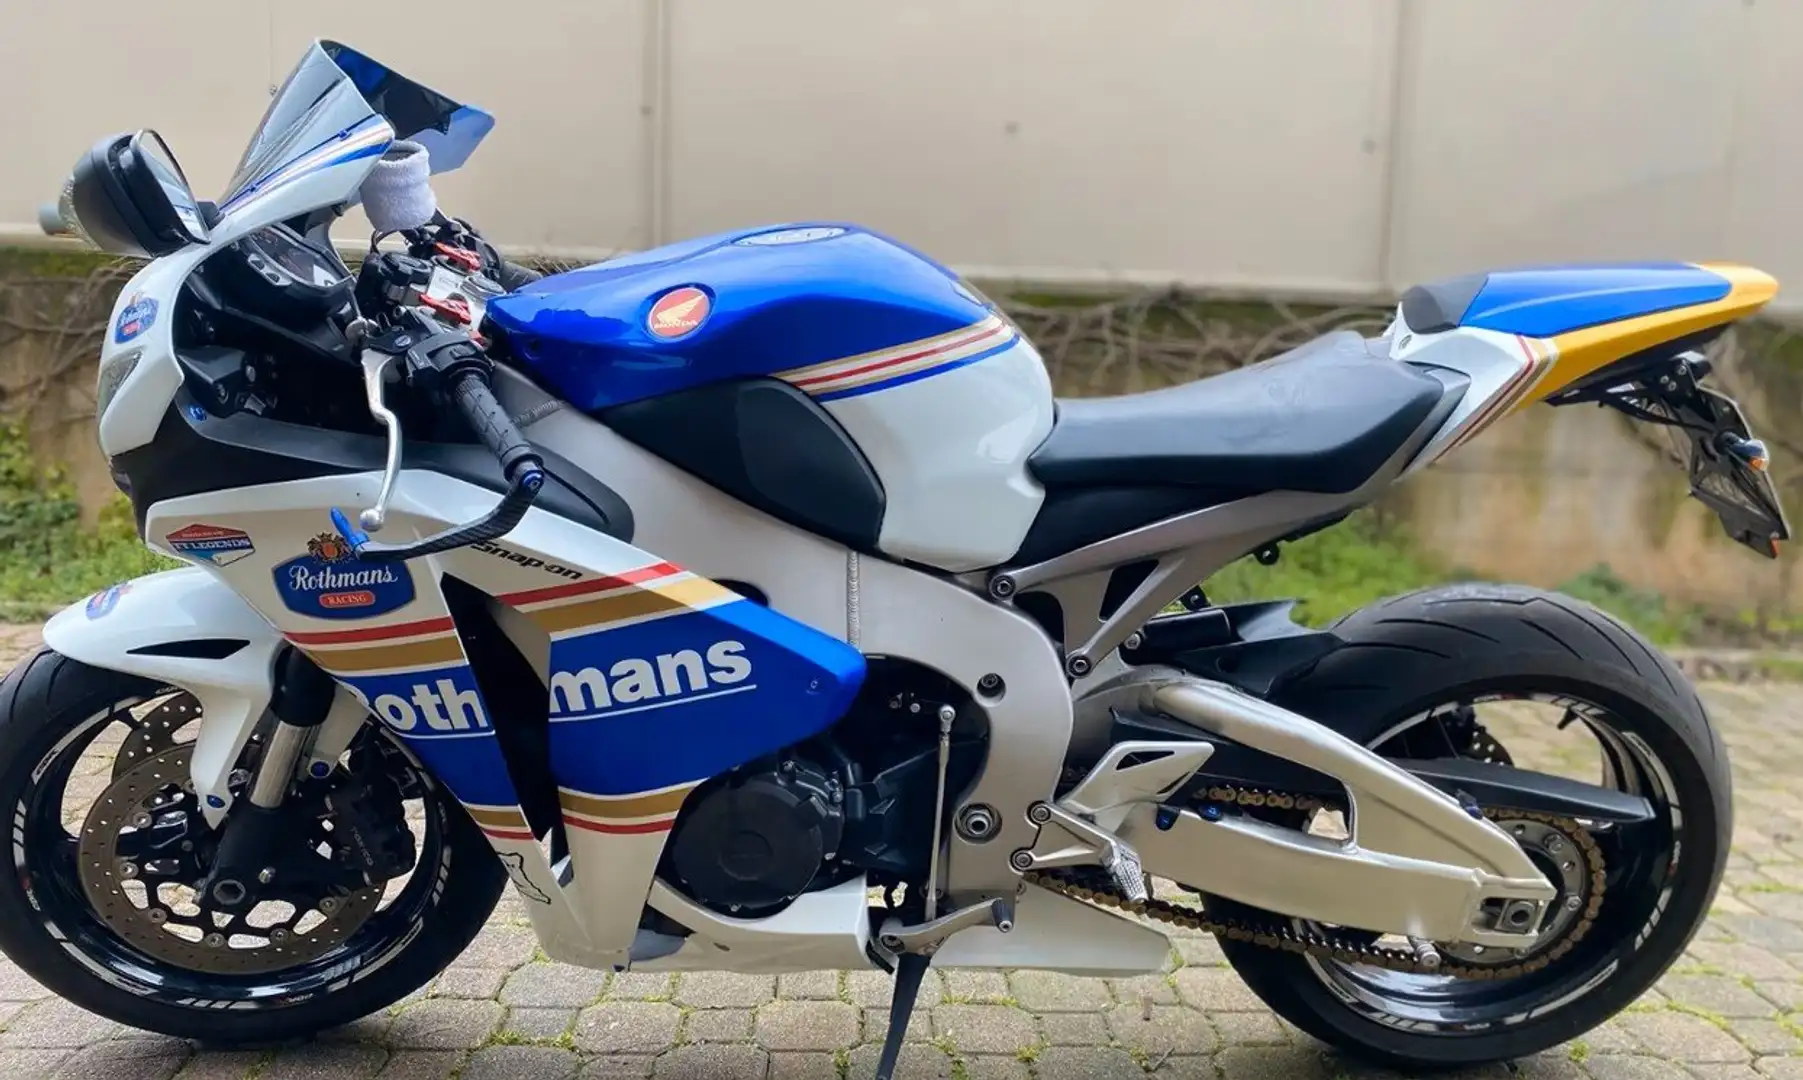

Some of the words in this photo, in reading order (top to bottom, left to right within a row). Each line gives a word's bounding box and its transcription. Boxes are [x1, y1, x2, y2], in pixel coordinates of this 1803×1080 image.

[190, 538, 251, 549] LEGENDS
[288, 565, 399, 591] Rothmans
[327, 594, 367, 606] RACING
